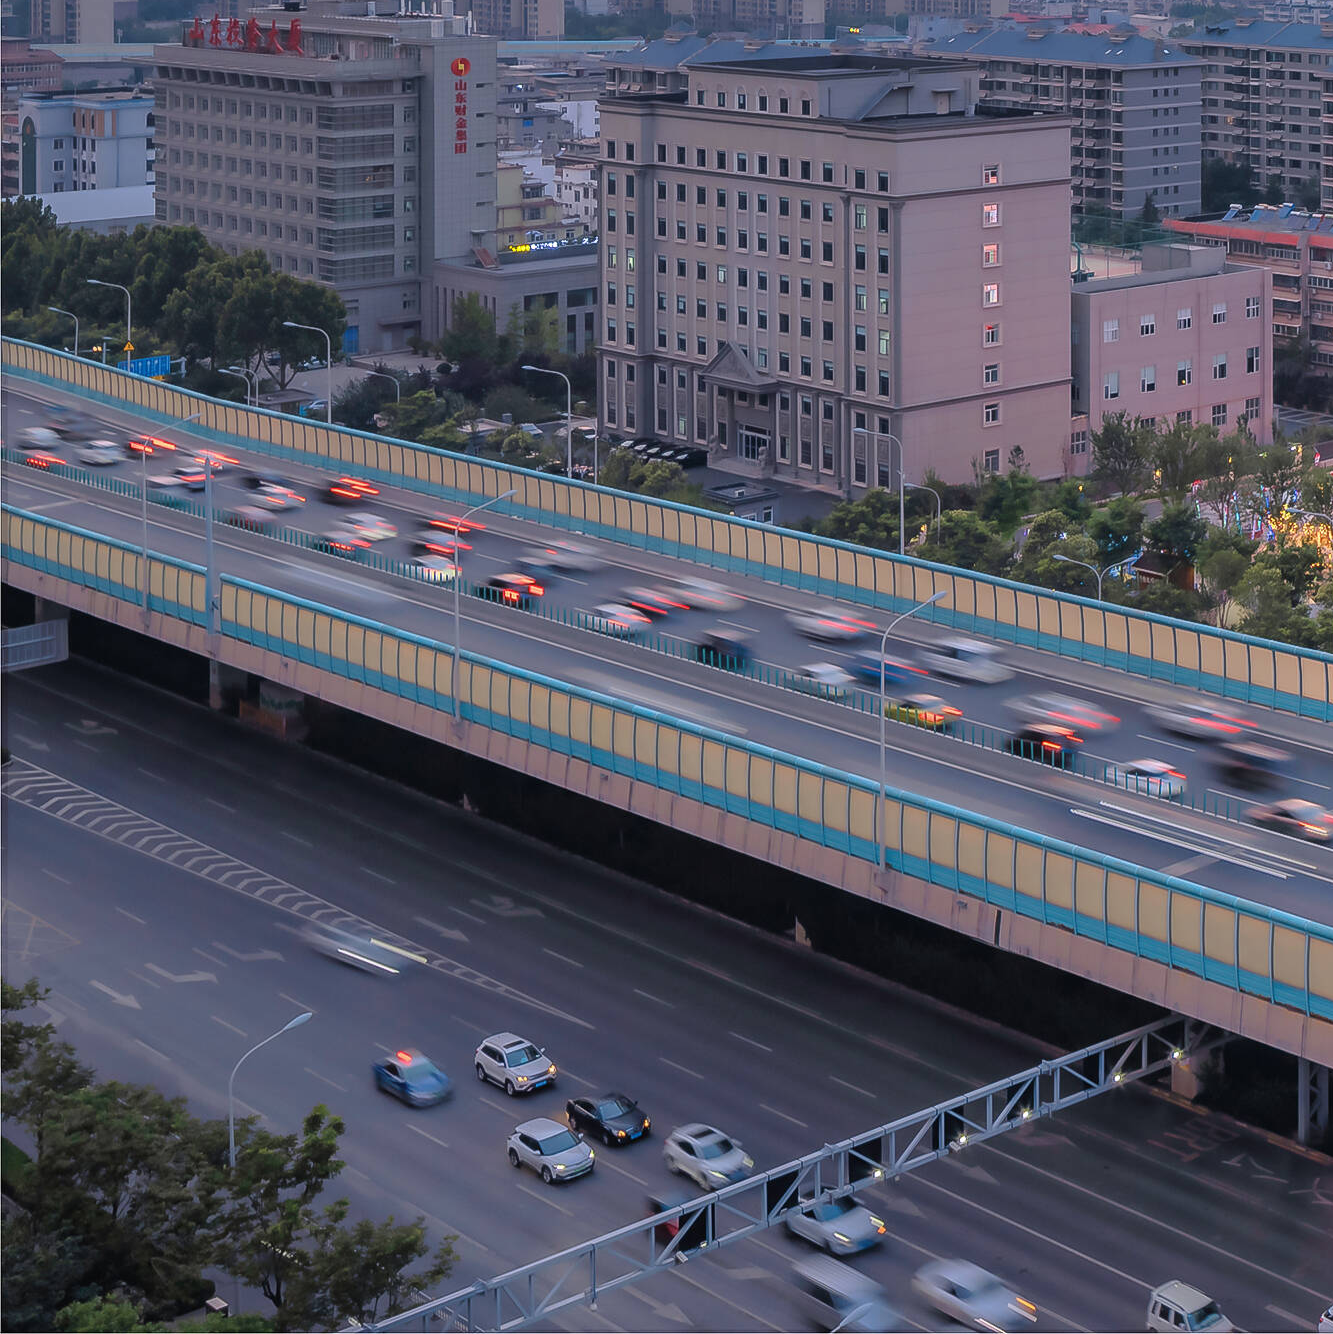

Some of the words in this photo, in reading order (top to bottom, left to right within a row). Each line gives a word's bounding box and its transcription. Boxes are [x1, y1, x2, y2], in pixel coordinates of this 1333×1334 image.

[454, 78, 468, 155] 山东财金集团
